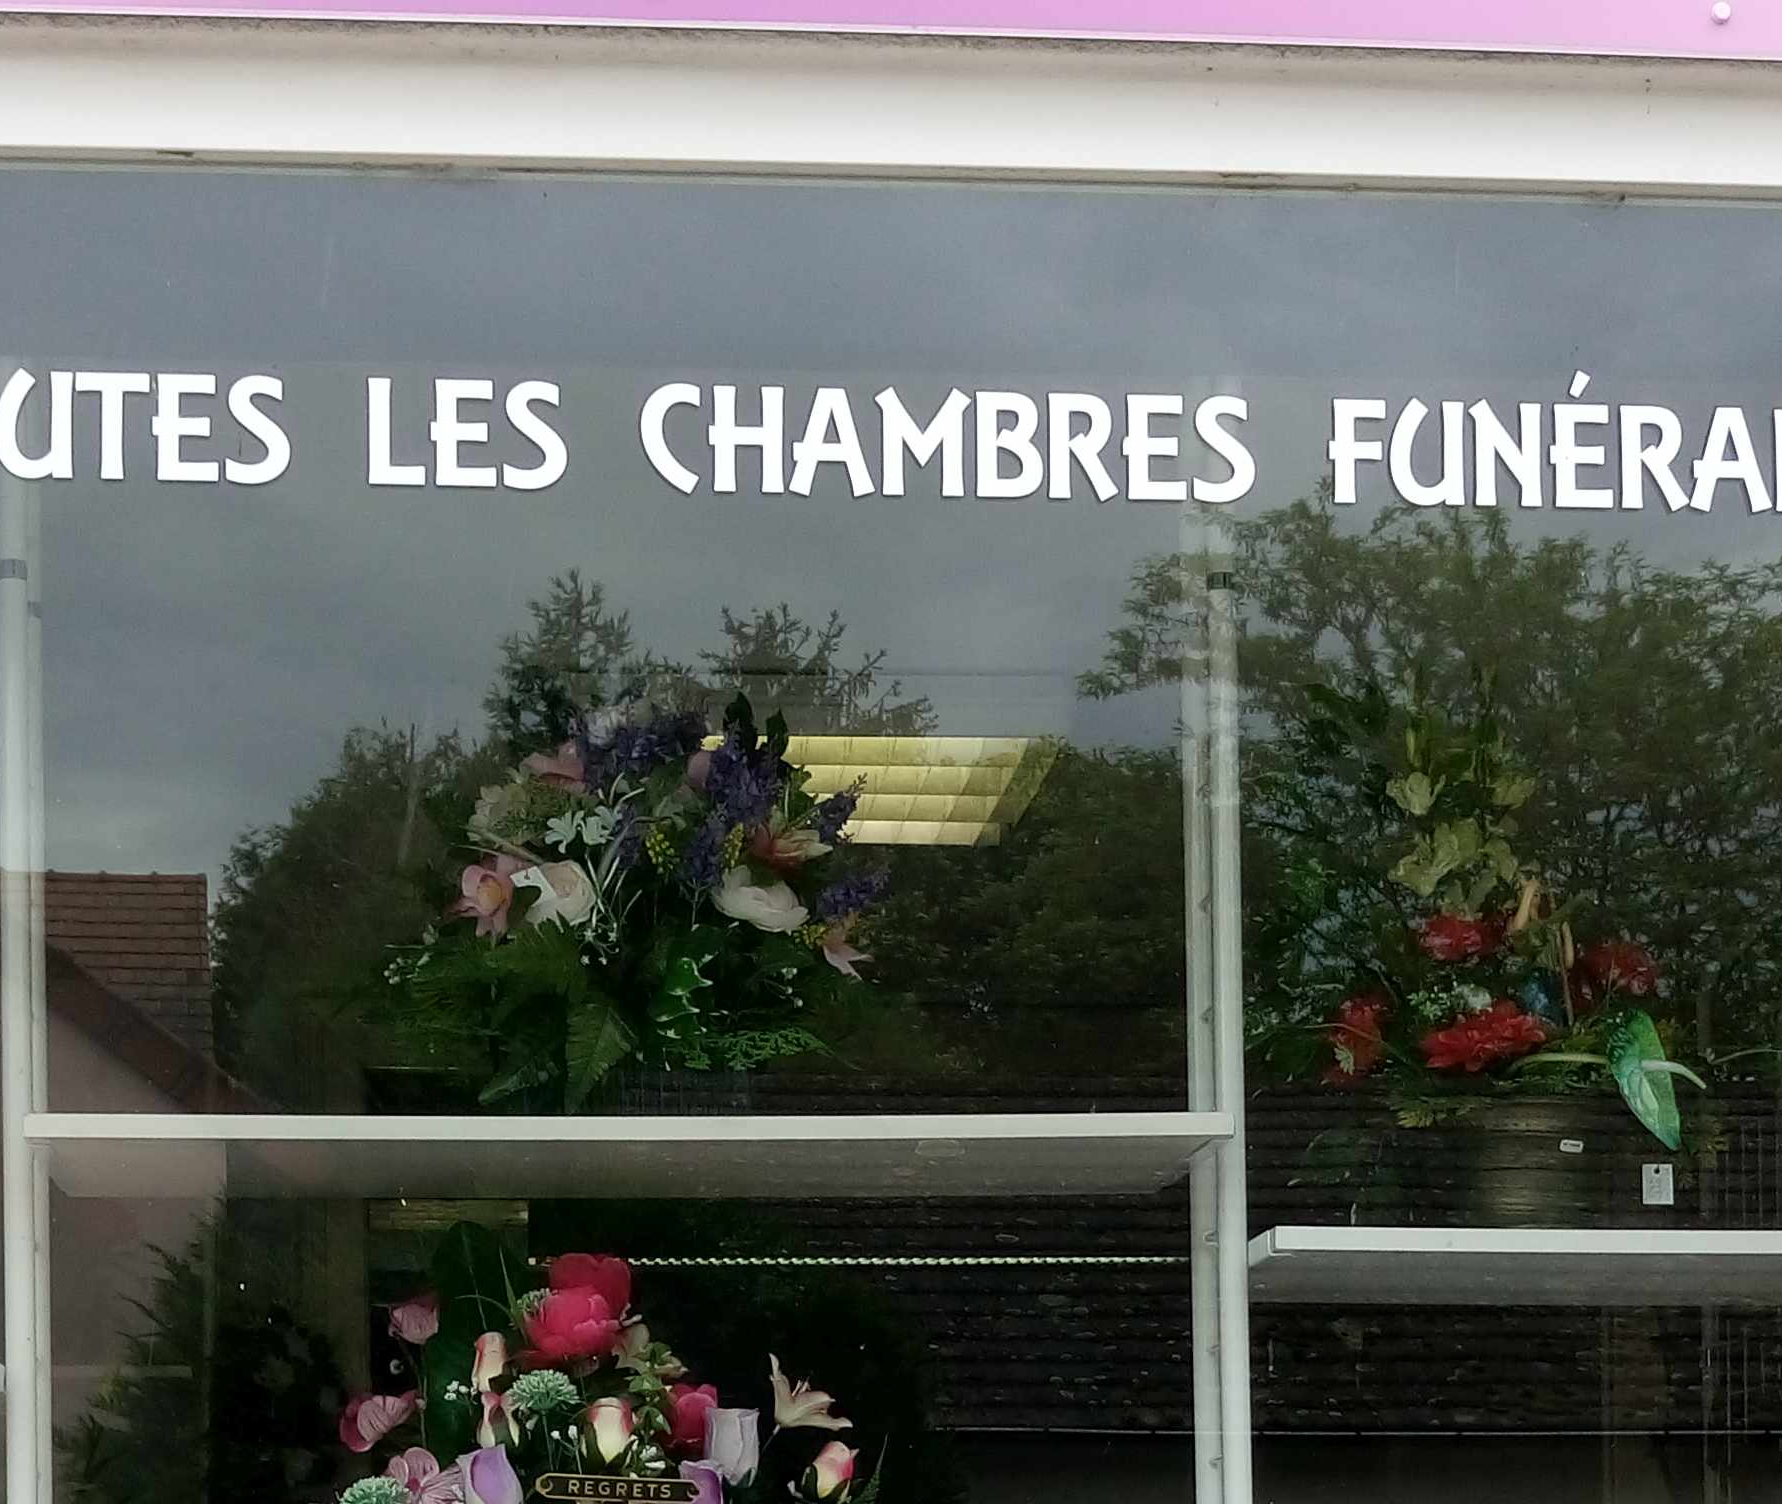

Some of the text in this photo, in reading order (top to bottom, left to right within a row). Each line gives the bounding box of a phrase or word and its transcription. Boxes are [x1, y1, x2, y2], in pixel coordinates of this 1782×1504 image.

[367, 375, 571, 491] LES
[638, 381, 1259, 504] CHAMBRES
[567, 1479, 671, 1498] REGRETS
